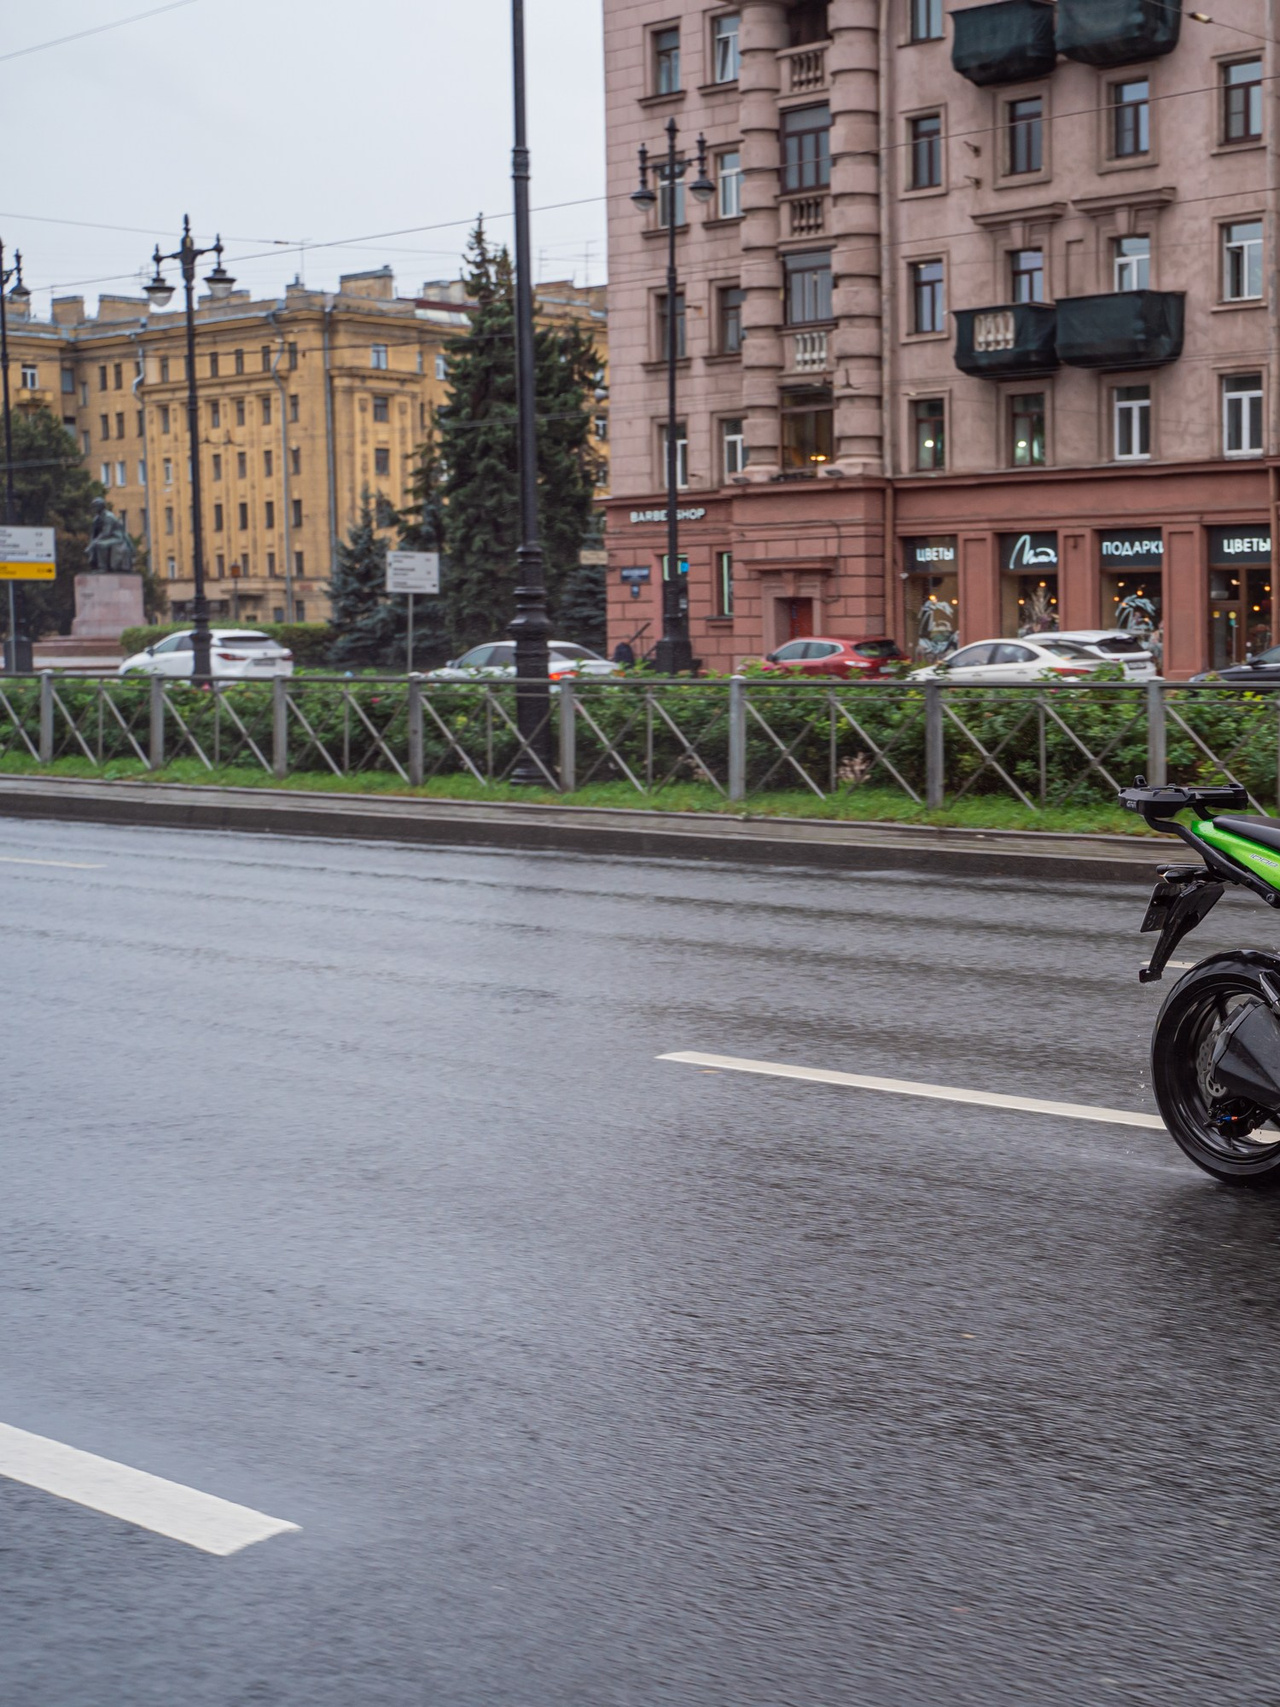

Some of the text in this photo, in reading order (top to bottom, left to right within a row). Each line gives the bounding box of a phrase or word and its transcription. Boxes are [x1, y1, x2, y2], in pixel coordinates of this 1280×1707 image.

[629, 507, 706, 523] BARBESHOP
[1222, 537, 1272, 554] ЦВЕТЫ
[915, 547, 955, 562] ЦВЕТЫ
